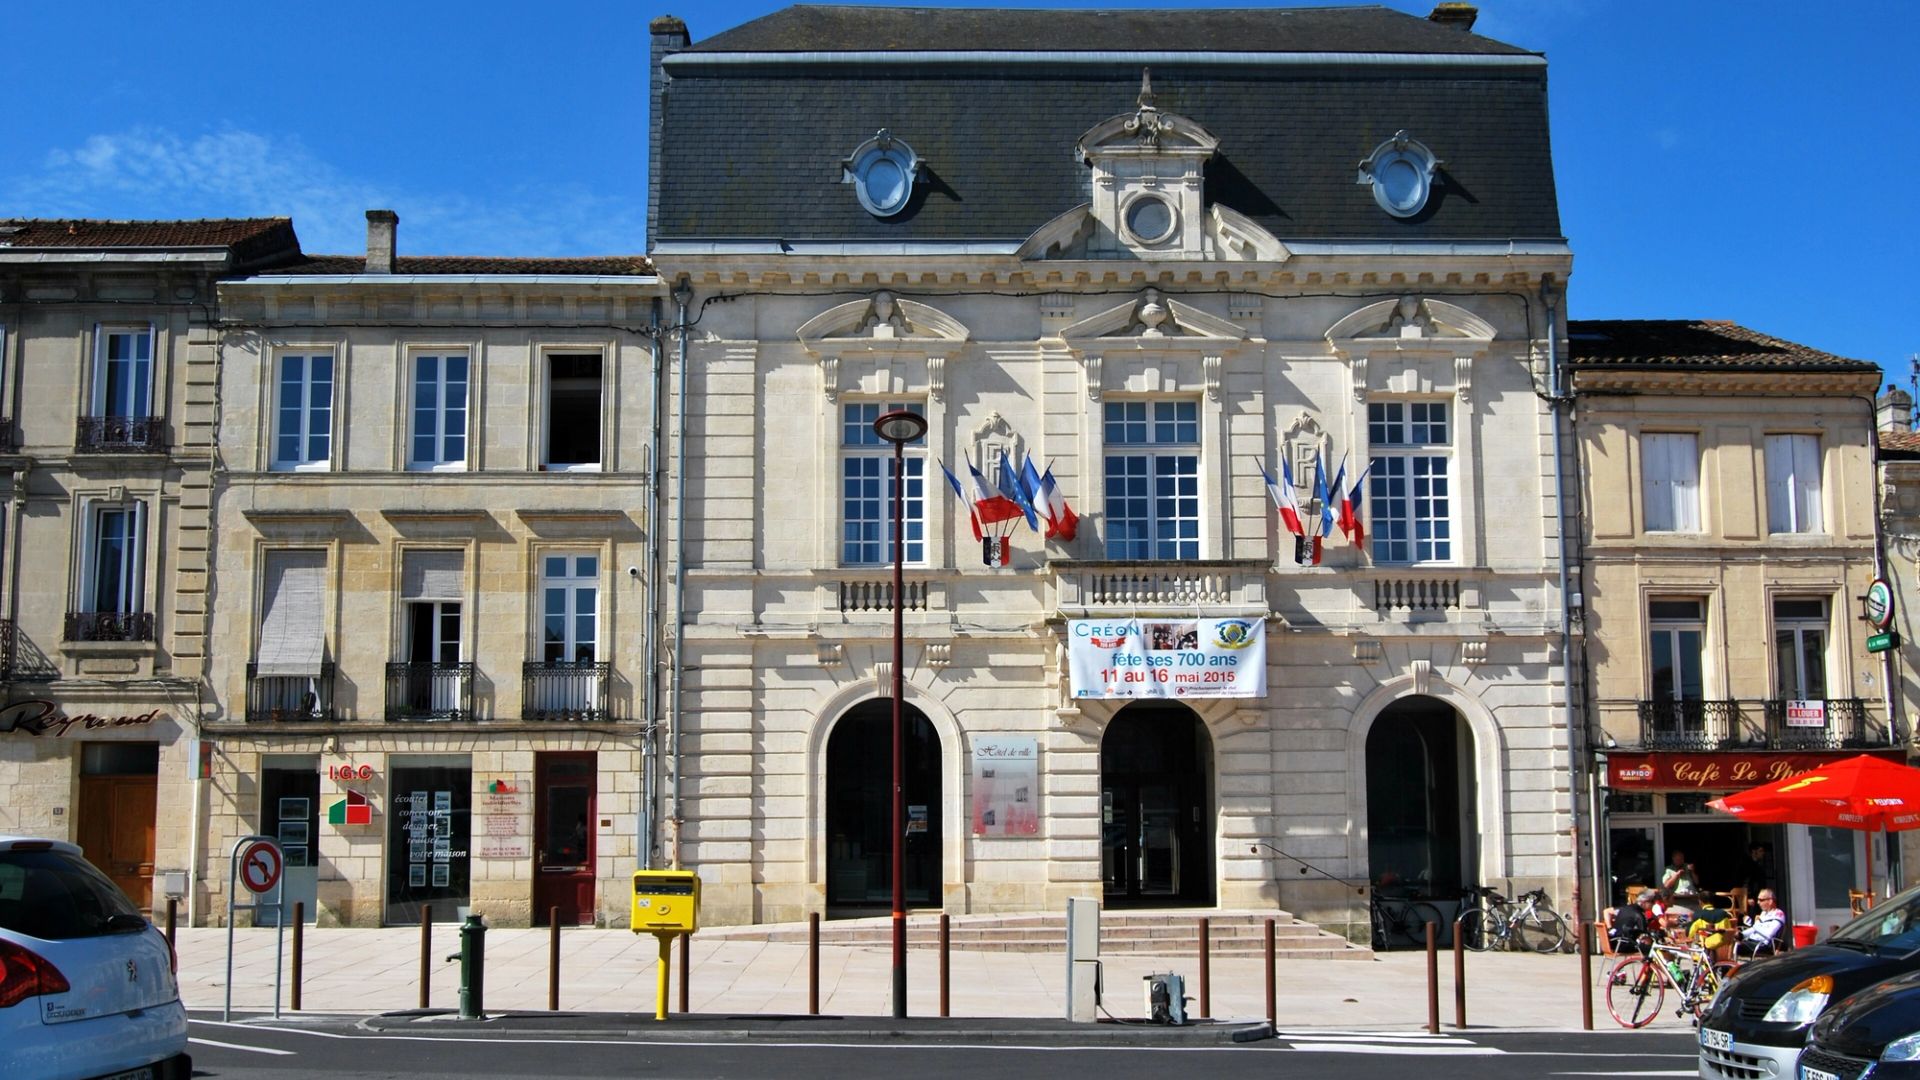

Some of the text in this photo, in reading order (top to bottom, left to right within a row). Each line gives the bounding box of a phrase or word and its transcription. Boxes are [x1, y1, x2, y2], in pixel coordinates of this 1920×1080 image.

[1075, 623, 1139, 637] CRÉON
[1112, 653, 1238, 667] fête ses 700 ans
[1101, 668, 1235, 683] 11 au 16 mai 2015
[1798, 709, 1820, 718] LOUER
[329, 765, 372, 779] I.G.C
[1619, 769, 1650, 777] RAPIDO
[1673, 761, 1720, 786] Café
[1730, 761, 1758, 781] Le
[434, 848, 468, 859] maison
